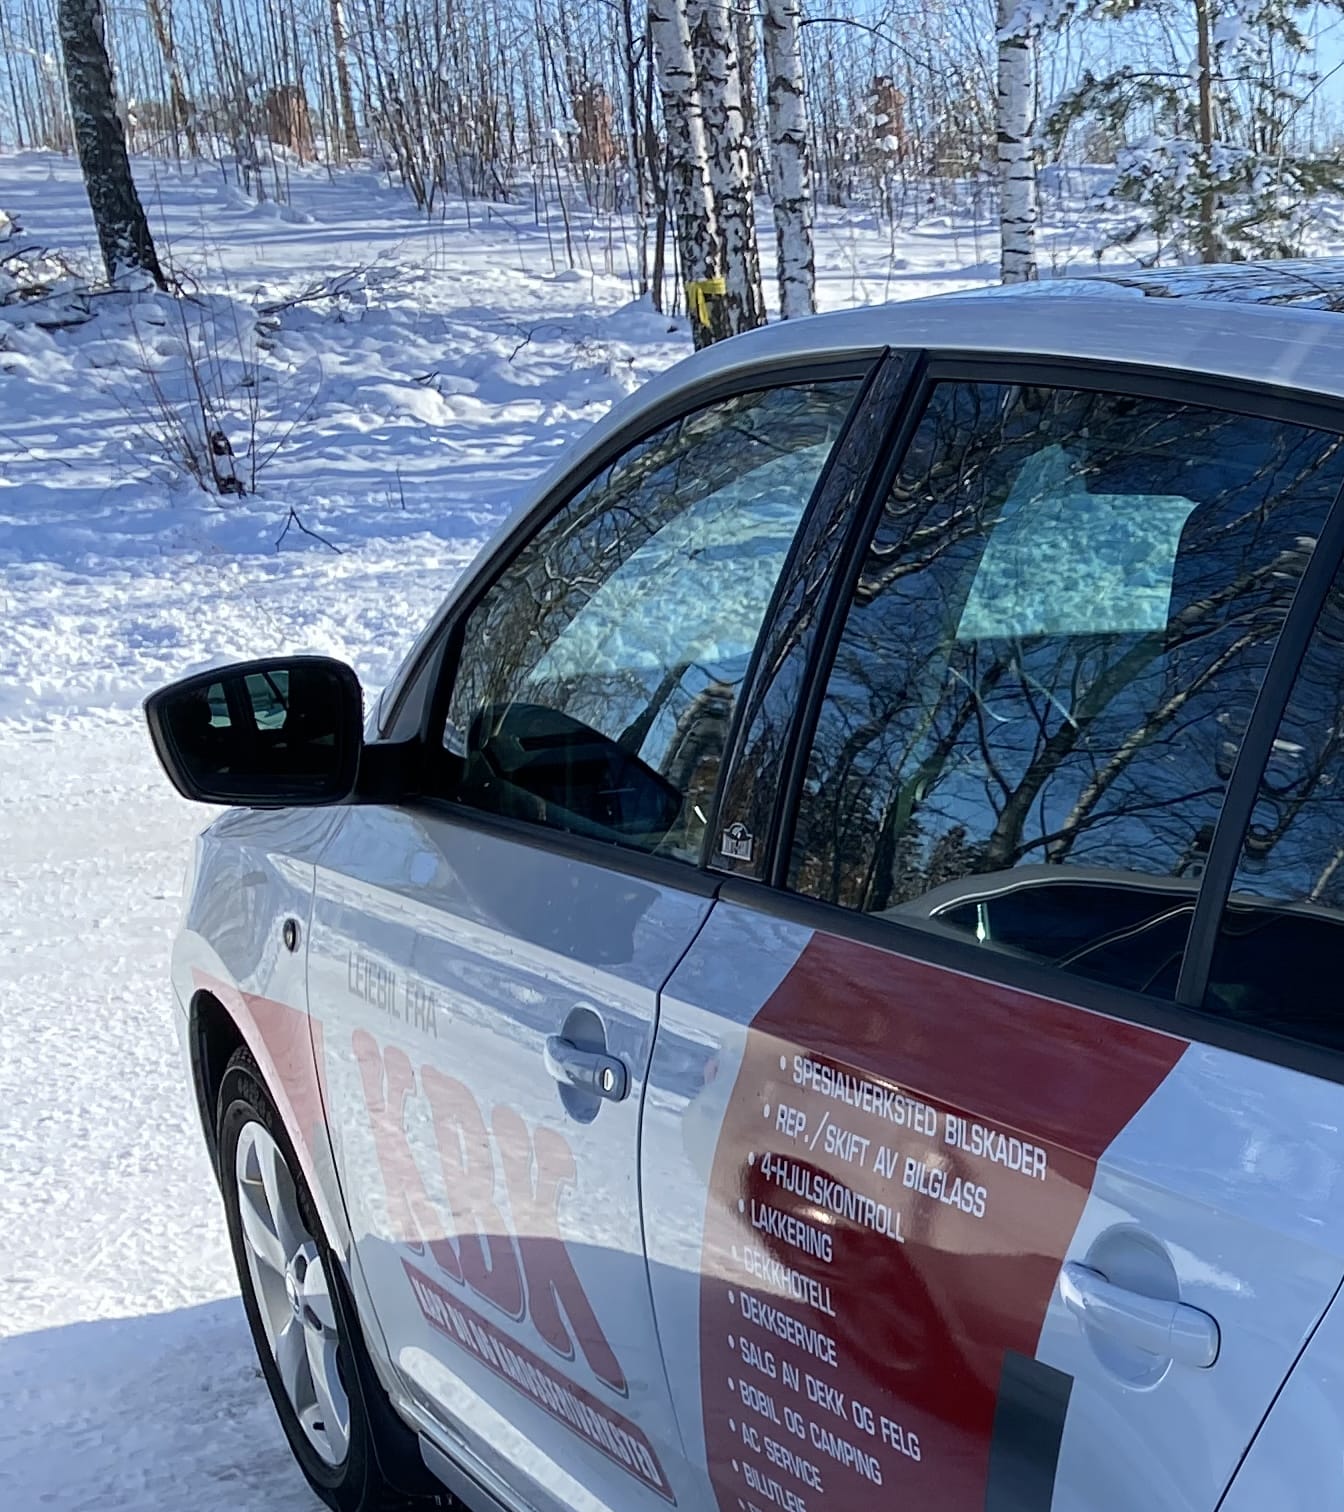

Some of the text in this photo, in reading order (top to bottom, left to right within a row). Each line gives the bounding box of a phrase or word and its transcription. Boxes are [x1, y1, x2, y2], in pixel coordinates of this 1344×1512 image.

[792, 1055, 1048, 1181] SPESIALVERKSTED BILSKADER
[351, 1029, 629, 1399] KBK
[760, 1151, 905, 1244] 4-HJULSKONTROLL
[873, 1146, 899, 1180] AV
[902, 1156, 988, 1218] BILGLASS
[750, 1198, 833, 1264] LAKKERING
[743, 1245, 837, 1318] DEKKHOTELL
[739, 1291, 839, 1368] DEKKSERVICE
[738, 1379, 883, 1486] BOBIL OG CAMPING
[739, 1336, 921, 1462] SALG AV DEKK OG FELG
[741, 1421, 825, 1494] AC SERVICE
